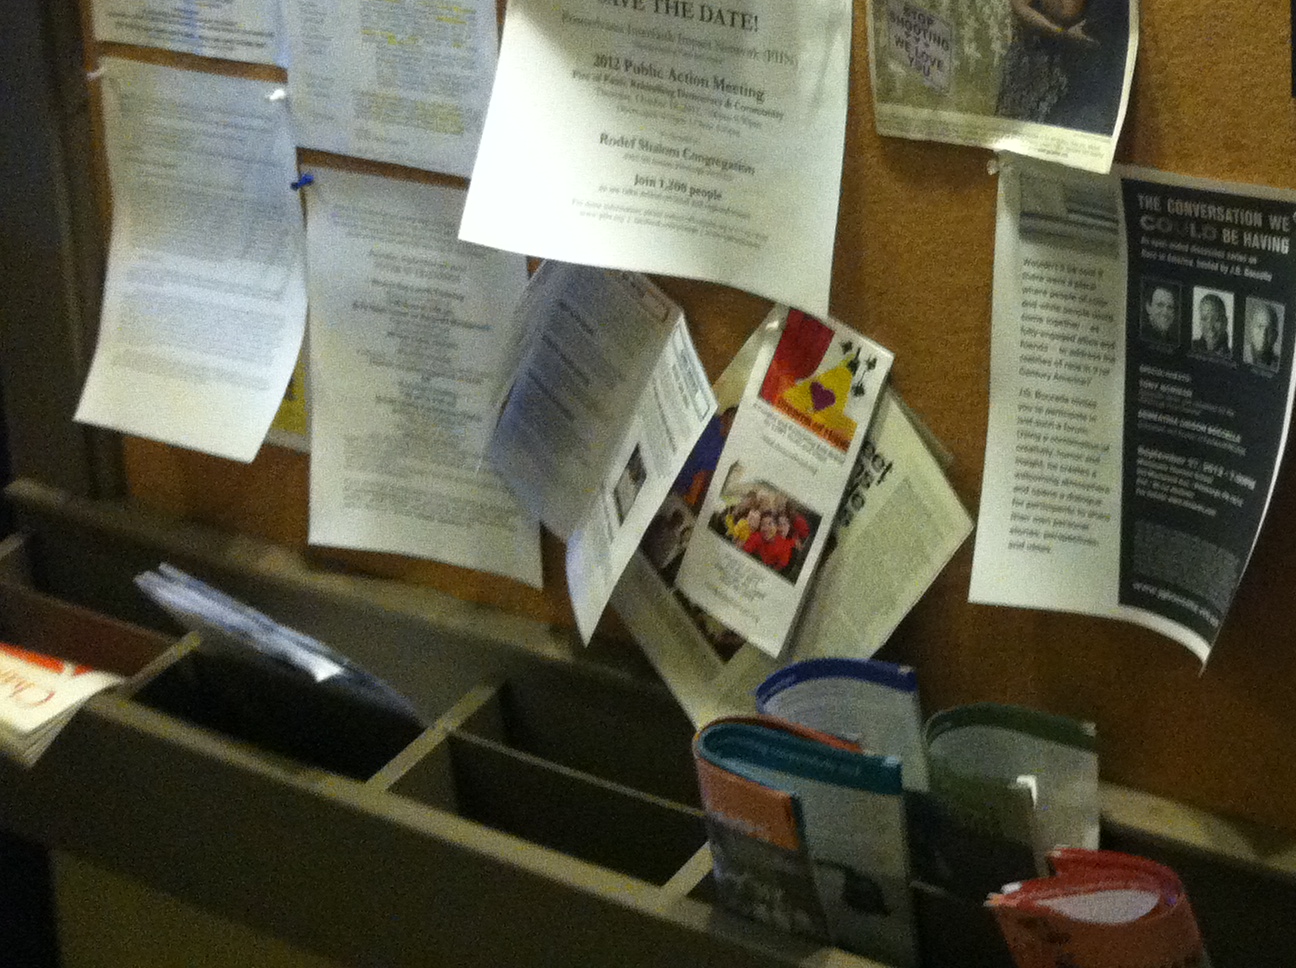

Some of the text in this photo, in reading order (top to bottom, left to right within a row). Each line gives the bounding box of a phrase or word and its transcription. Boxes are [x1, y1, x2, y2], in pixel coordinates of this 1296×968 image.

[698, 2, 760, 33] DATE!
[623, 58, 663, 80] Public
[668, 67, 710, 90] Action
[712, 75, 766, 105] Meeting
[599, 132, 756, 177] Rodef Shalom Congregation
[633, 174, 722, 202] Join people
[1137, 193, 1291, 233] THE CONVERSATION WE
[1222, 227, 1240, 245] BE
[1243, 232, 1291, 255] HAVING
